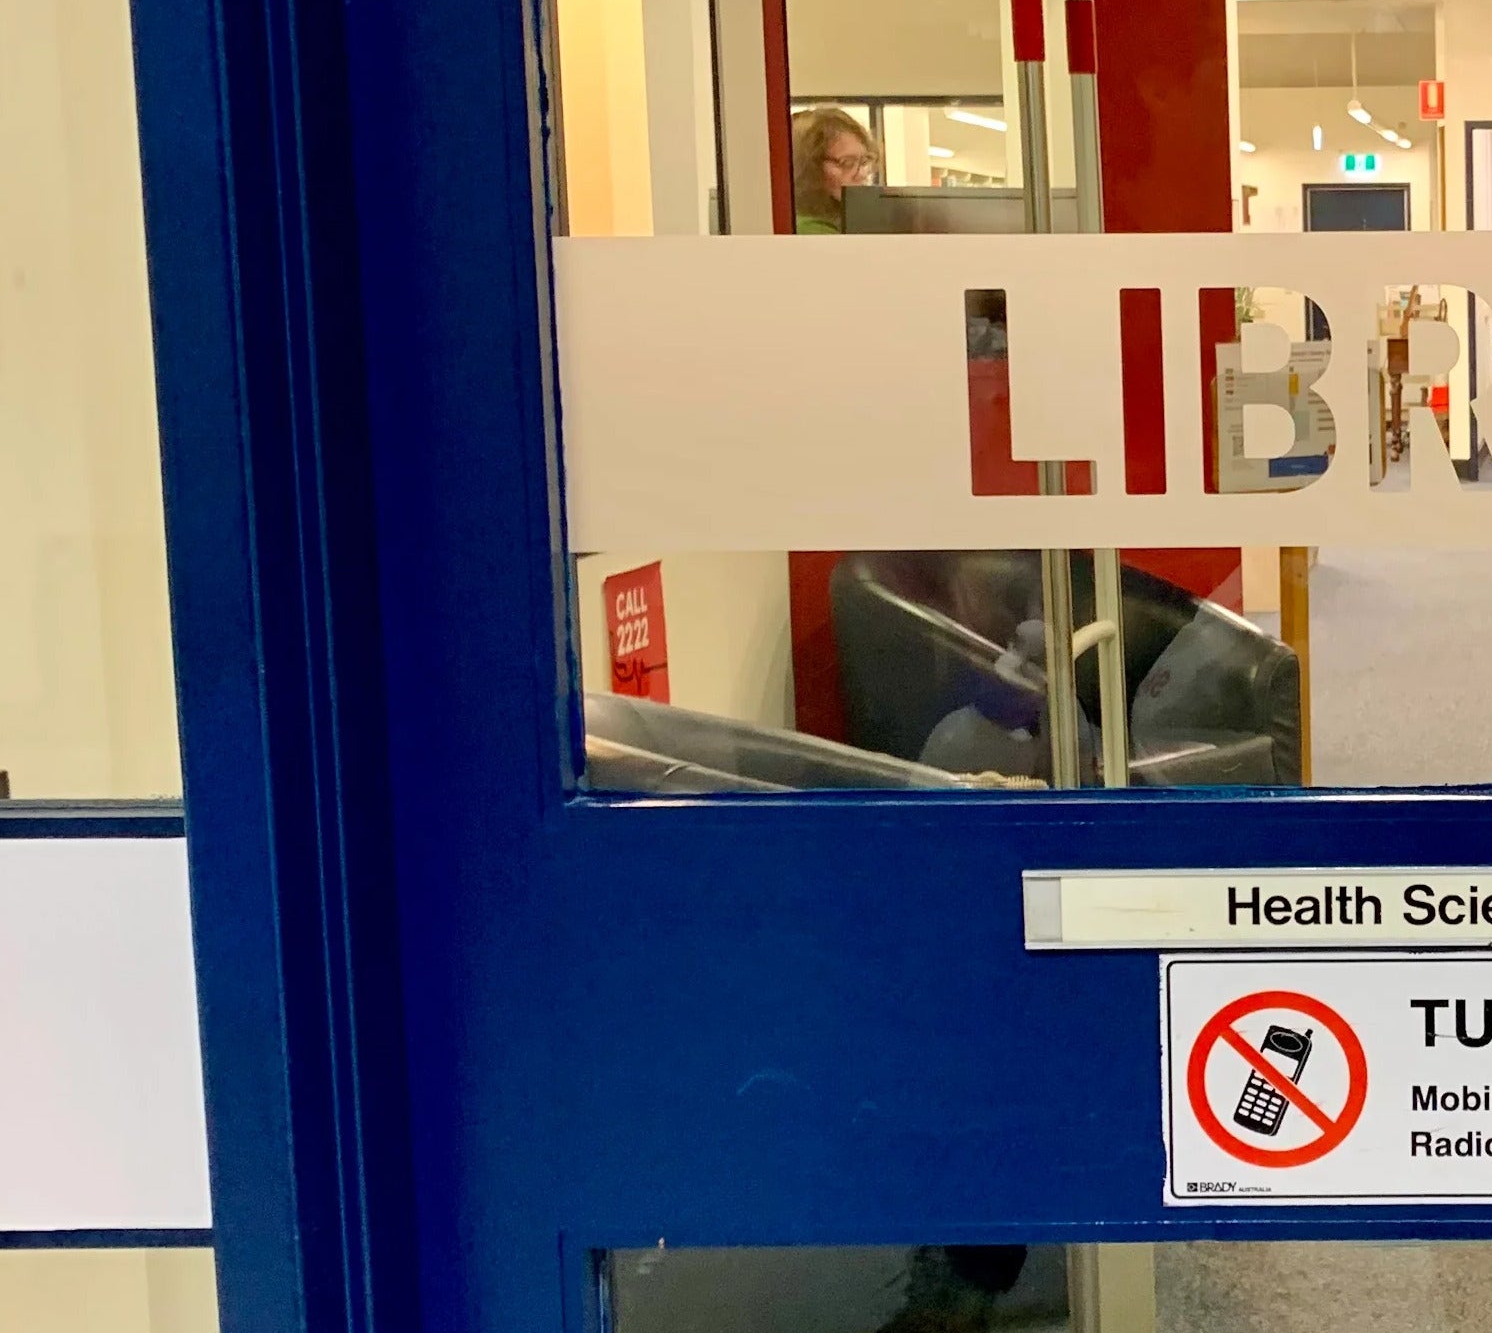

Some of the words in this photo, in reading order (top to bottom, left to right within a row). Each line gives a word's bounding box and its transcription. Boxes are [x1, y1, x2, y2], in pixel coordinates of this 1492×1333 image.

[615, 587, 648, 620] CALL
[617, 616, 650, 657] 2222
[1227, 885, 1382, 926] Health
[1199, 1182, 1237, 1193] BRADY
